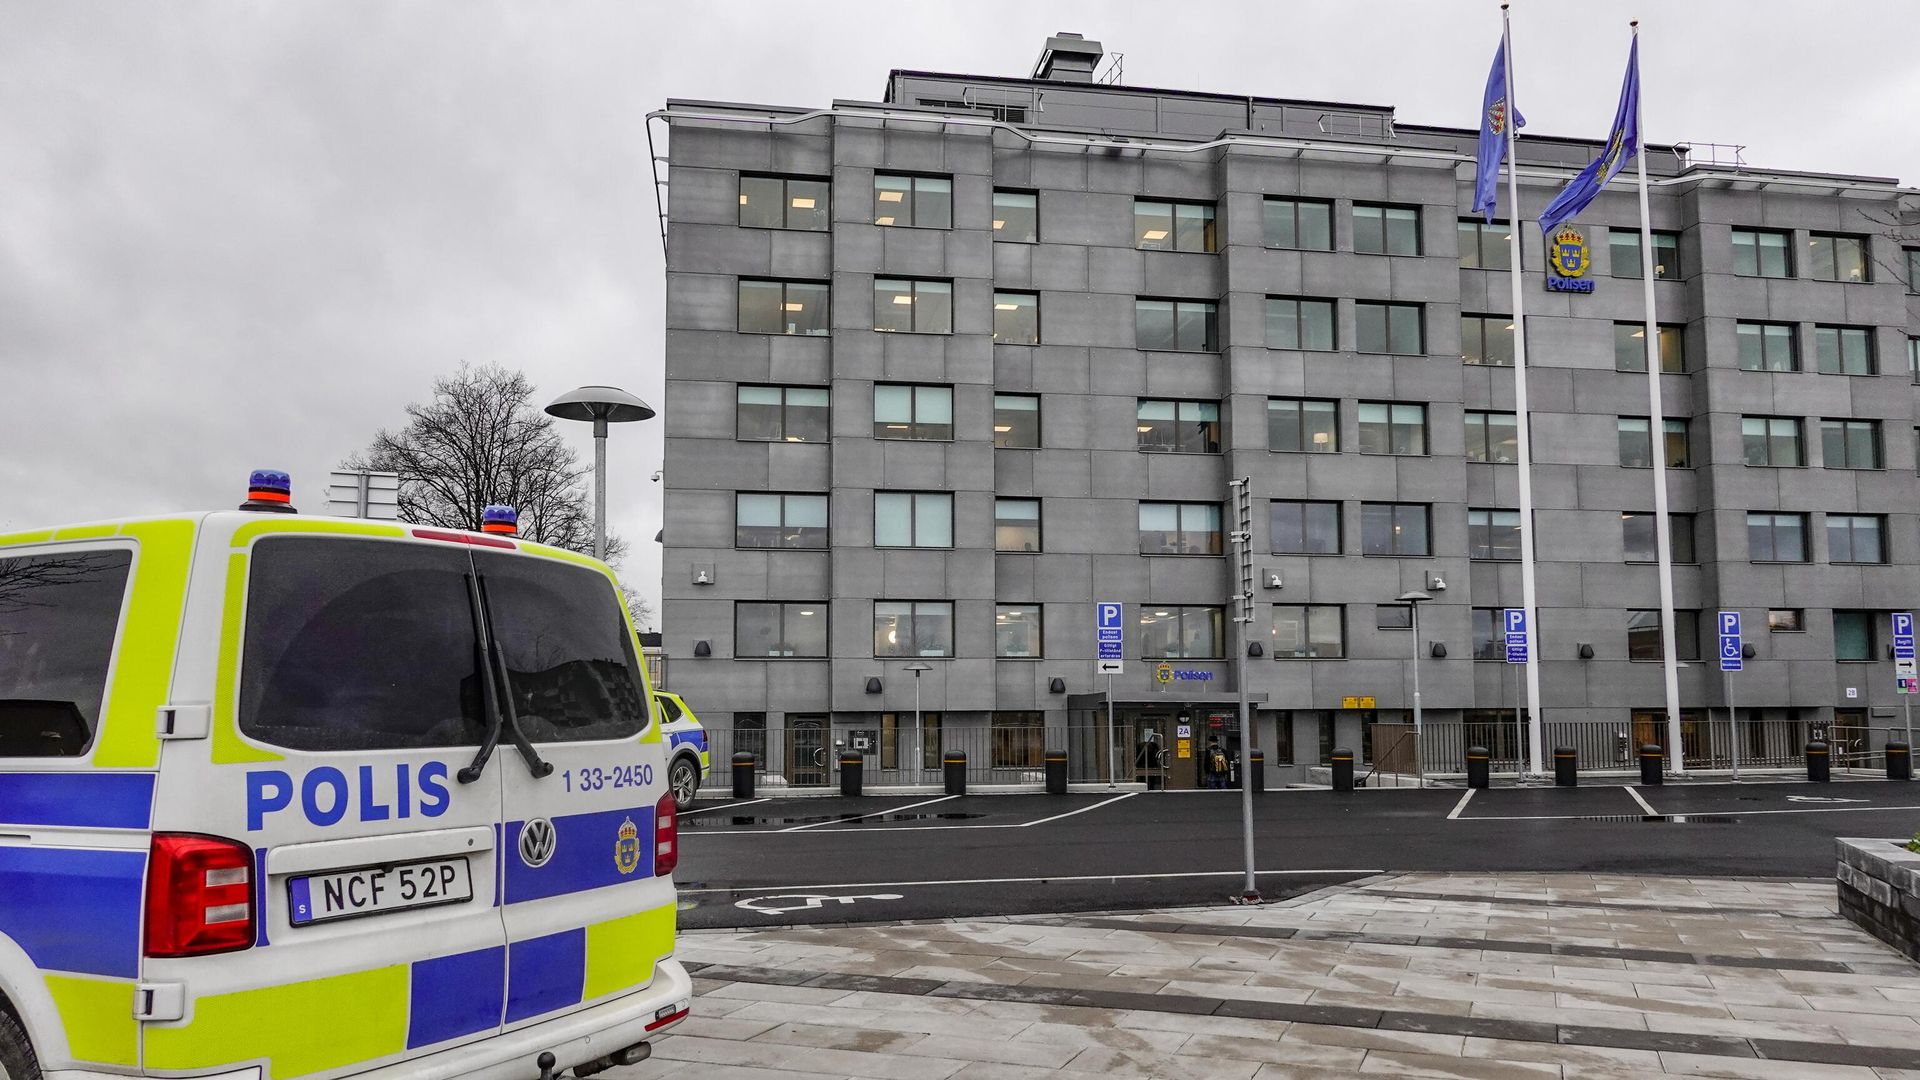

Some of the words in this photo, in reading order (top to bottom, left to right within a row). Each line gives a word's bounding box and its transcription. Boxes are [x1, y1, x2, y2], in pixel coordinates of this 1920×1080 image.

[1547, 277, 1595, 291] Polisen
[1104, 606, 1117, 626] P
[1510, 612, 1523, 631] P
[1724, 615, 1736, 633] P
[1898, 616, 1910, 634] P
[1173, 669, 1213, 681] Polisen
[1178, 727, 1190, 735] 2A
[562, 770, 571, 792] 1
[580, 764, 653, 792] 33-2450
[246, 761, 450, 832] POLIS
[299, 904, 306, 914] S
[324, 872, 387, 912] NCF
[399, 865, 456, 900] 52P
